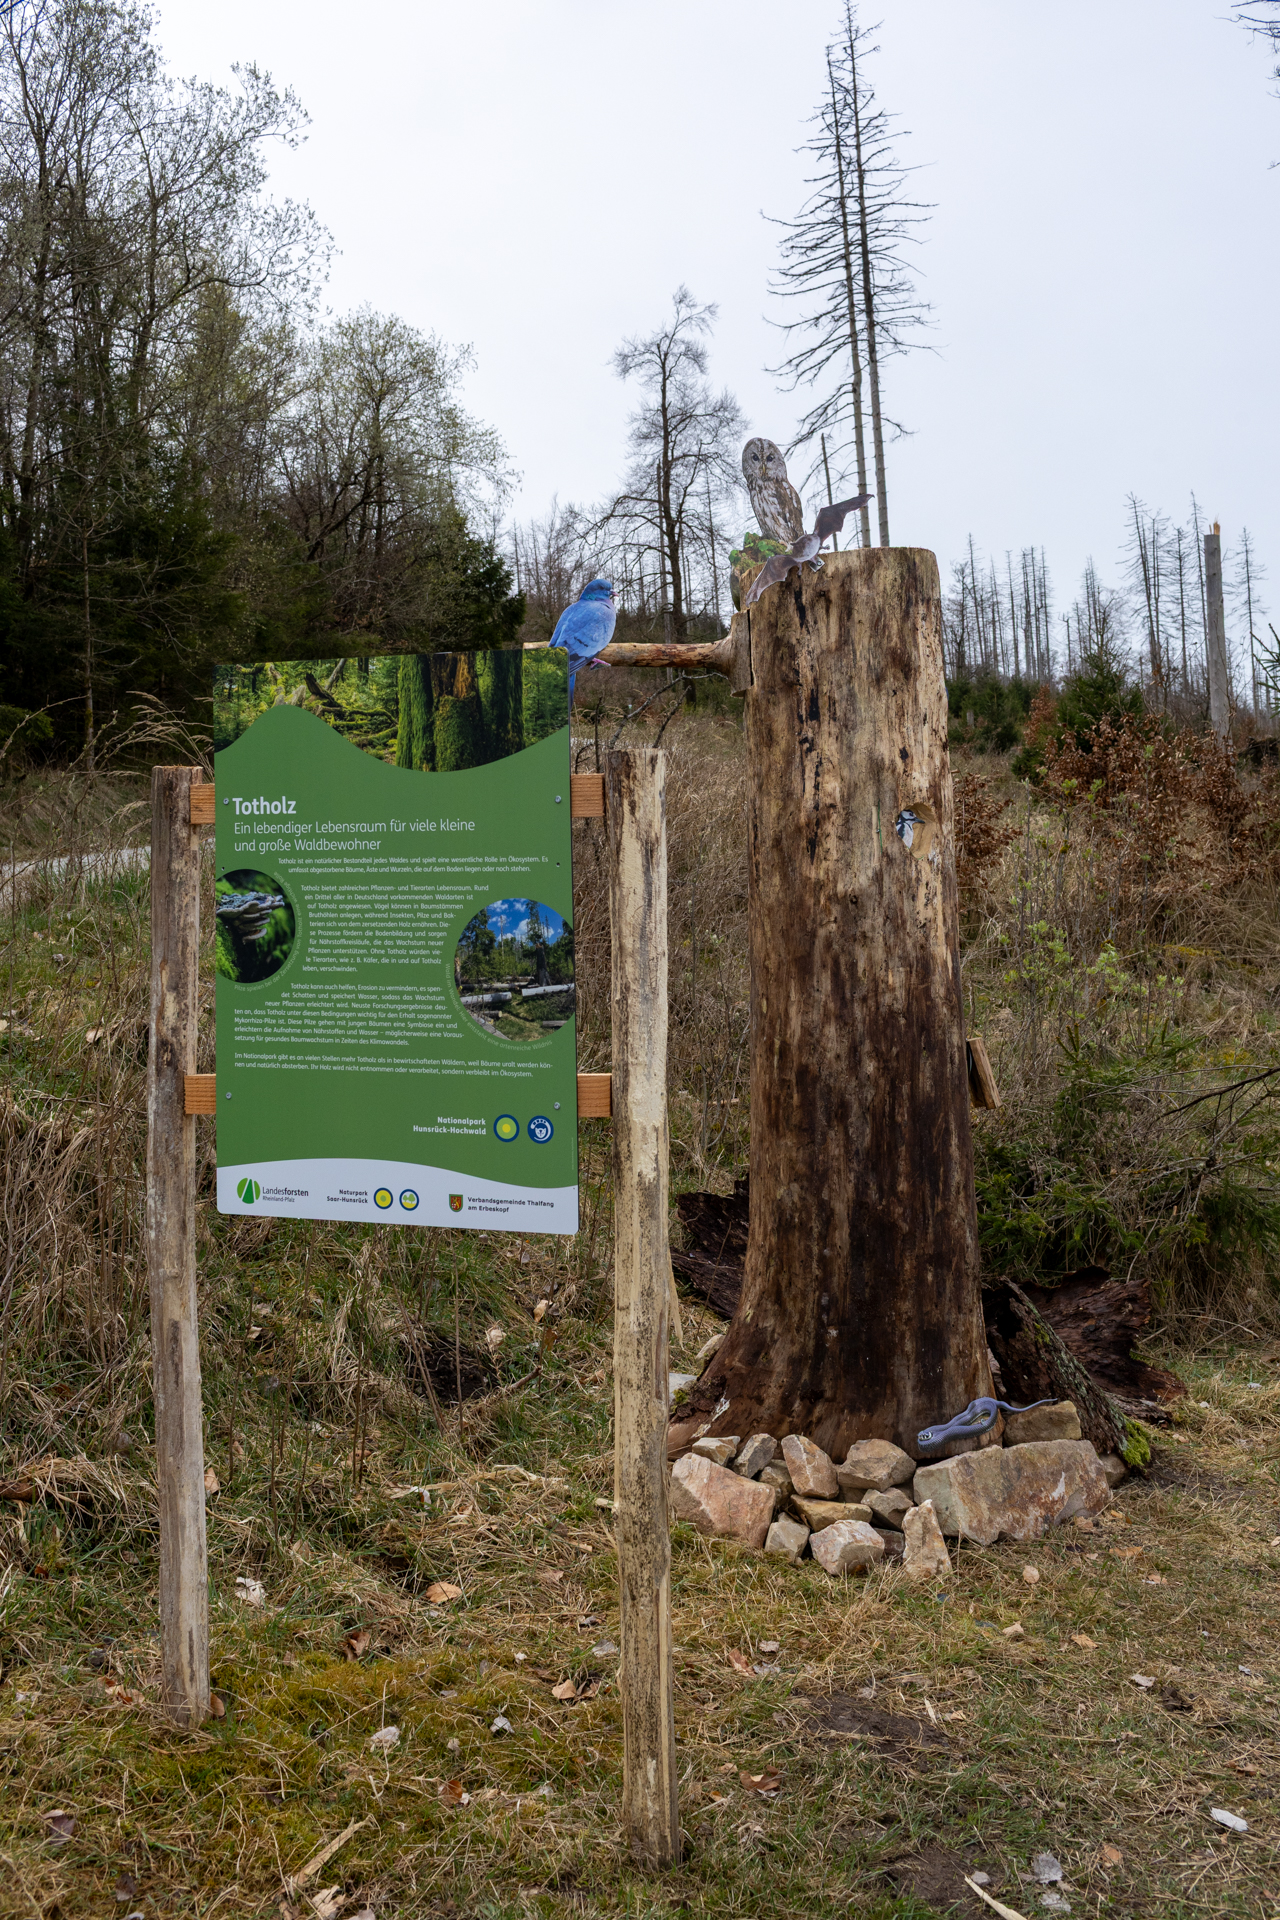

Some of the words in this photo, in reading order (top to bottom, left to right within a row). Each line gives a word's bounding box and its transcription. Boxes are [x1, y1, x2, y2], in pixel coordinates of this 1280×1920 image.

[232, 796, 296, 815] Totholz
[234, 822, 250, 834] Ein
[254, 821, 312, 836] lebendiger
[316, 821, 386, 833] Lebensraum
[390, 819, 406, 832] für
[410, 819, 436, 831] viele
[440, 819, 475, 831] kleine
[234, 839, 256, 851] und
[259, 839, 291, 854] große
[294, 838, 381, 851] Waldbewohner
[373, 857, 387, 865] jedes
[422, 856, 436, 865] spielt
[310, 866, 344, 874] abgestorbene
[465, 865, 481, 874] liegen
[374, 902, 389, 910] Vögel
[375, 930, 413, 938] Bodenbildung
[331, 992, 355, 1001] speichert
[372, 1002, 432, 1012] Forschungsergebnisse
[321, 1010, 356, 1019] Bedingungen
[357, 1011, 377, 1019] wichtig
[417, 1012, 452, 1021] sogenannter
[235, 1017, 276, 1026] Mykorrhiza-Pilze
[318, 1019, 335, 1028] gehen
[407, 1021, 433, 1030] Symbiose
[385, 1029, 428, 1038] möglicherweise
[235, 1034, 255, 1043] setzung
[264, 1035, 290, 1044] gesundes
[243, 1052, 276, 1061] Nationalpark
[393, 1057, 440, 1065] bewirtschafteten
[437, 1117, 486, 1126] Nationalpark
[413, 1125, 486, 1134] Hunsrück-Hochwald
[263, 1187, 308, 1196] Landesforsten
[468, 1197, 525, 1206] Verbandsgemeinde
